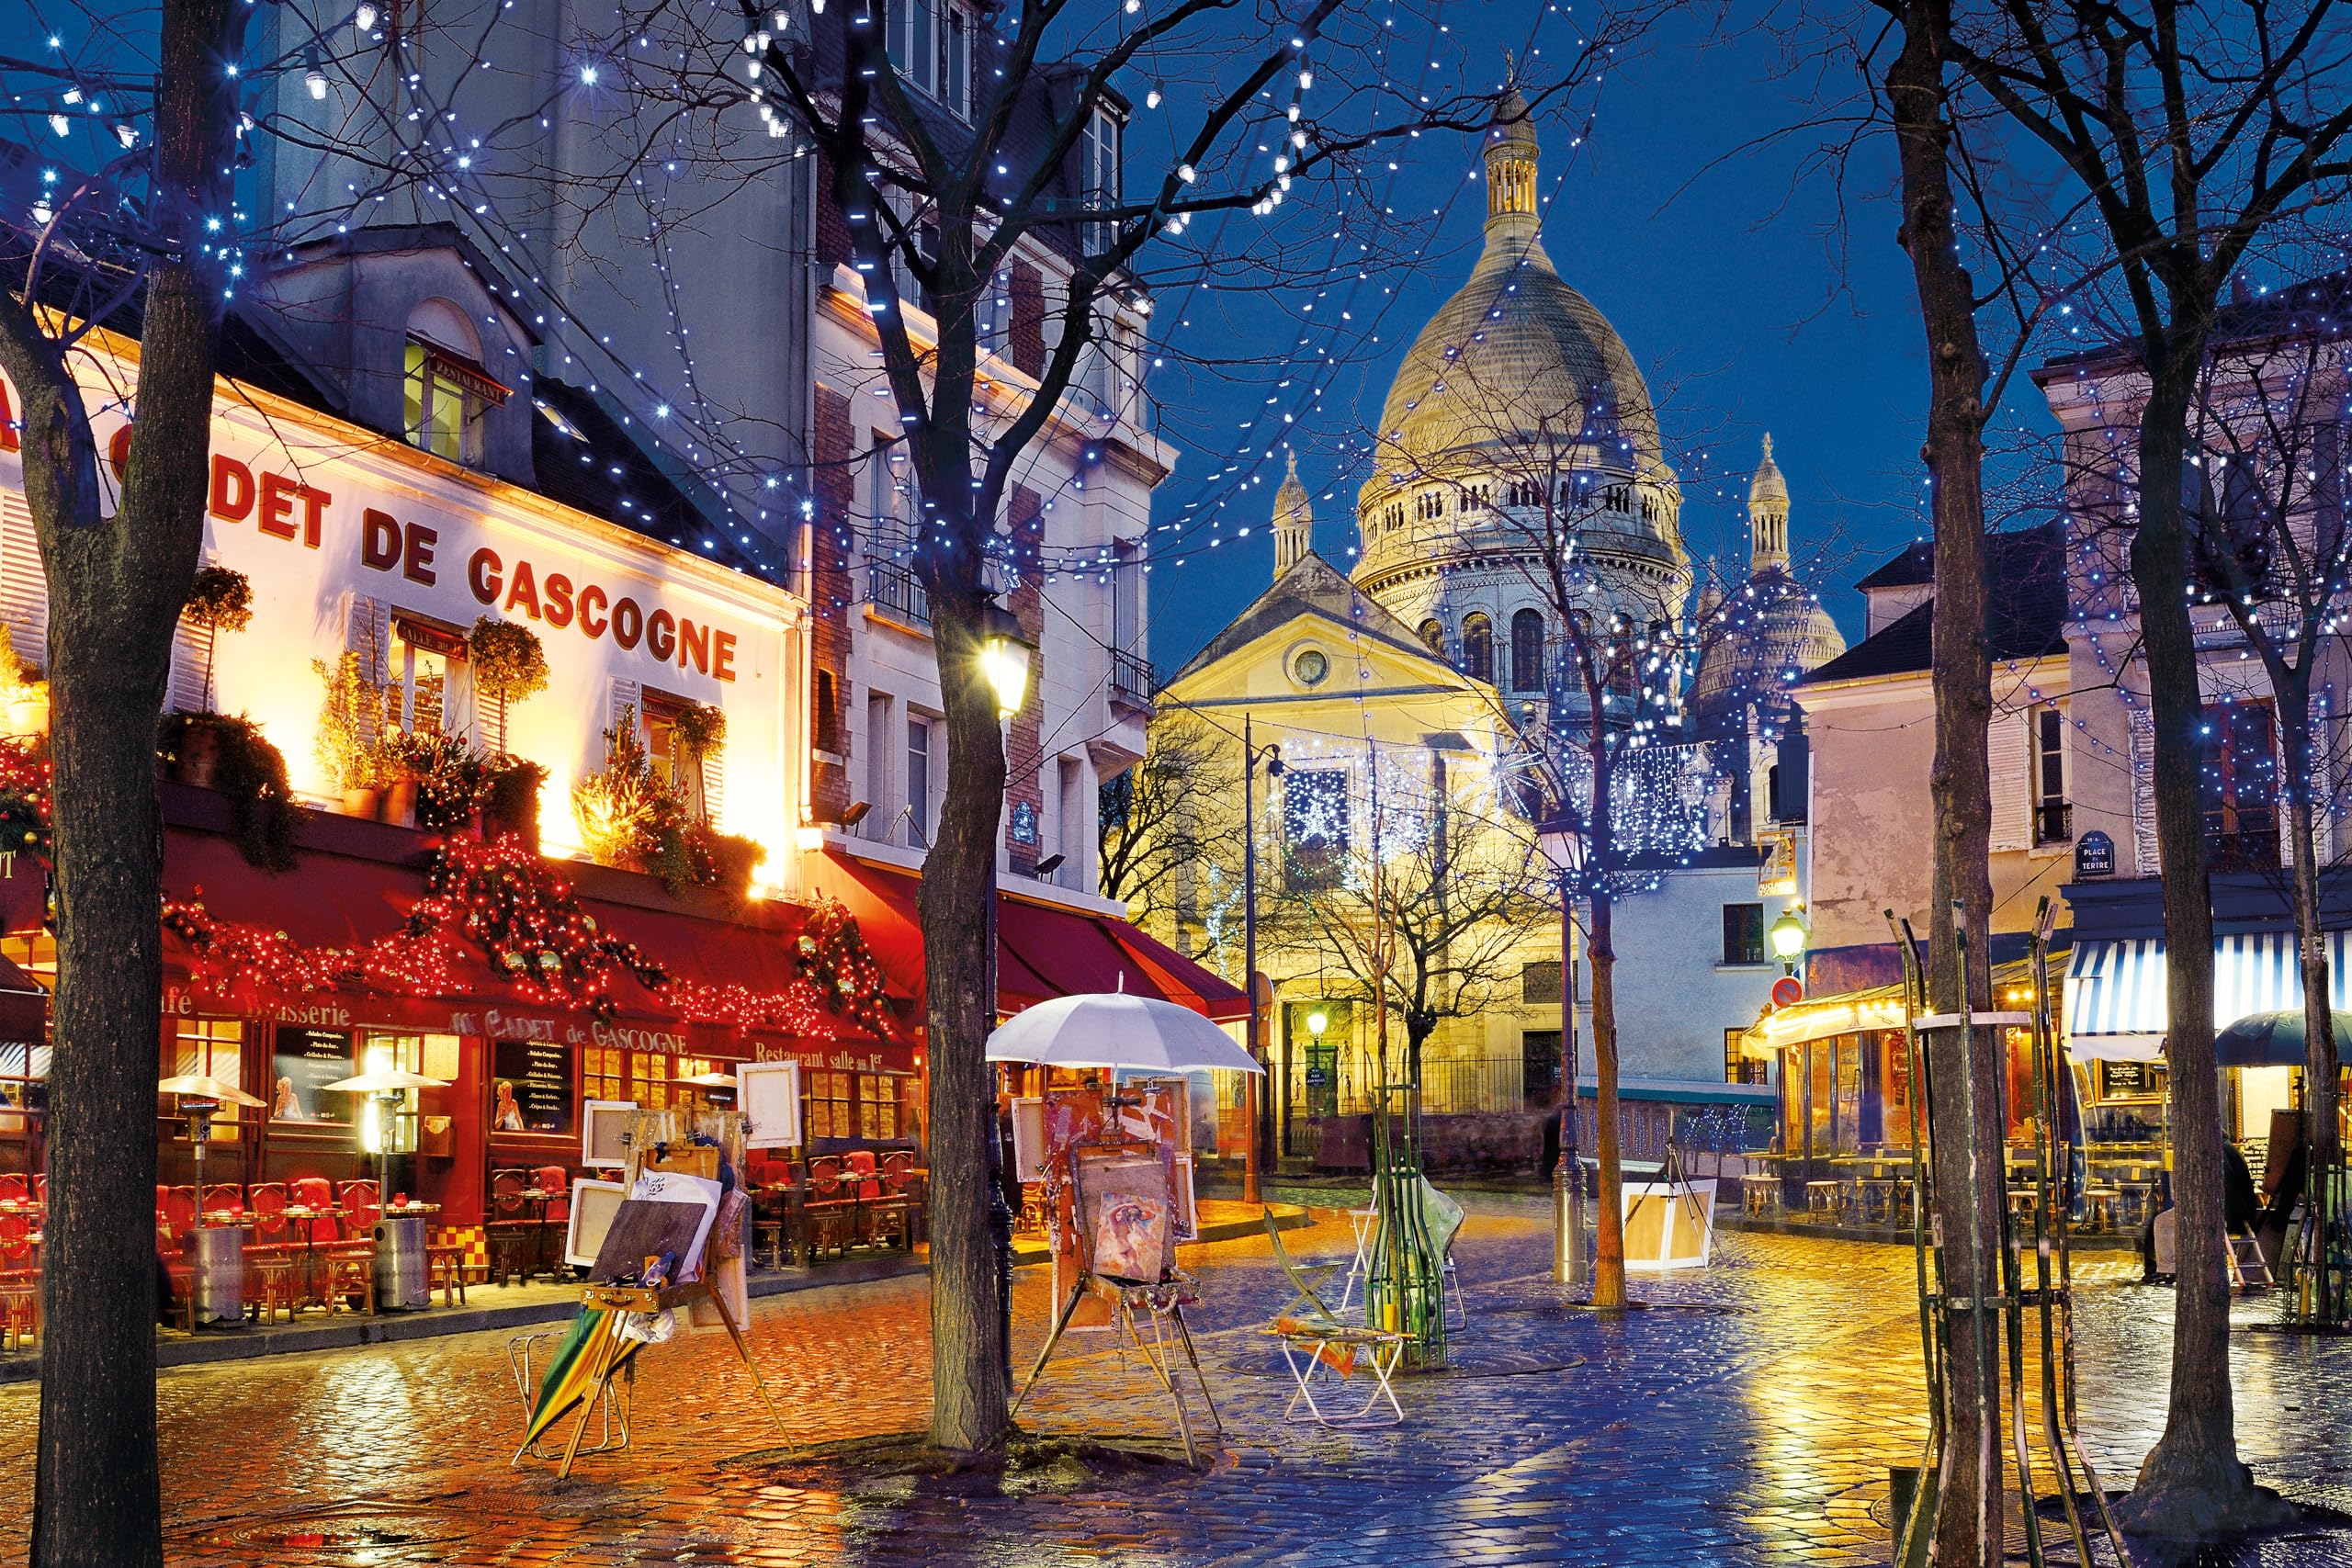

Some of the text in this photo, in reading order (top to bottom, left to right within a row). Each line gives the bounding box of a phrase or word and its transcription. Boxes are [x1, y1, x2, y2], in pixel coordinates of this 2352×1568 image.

[362, 507, 438, 587] DE
[468, 547, 737, 682] GASCOGNE
[2082, 861, 2109, 870] TERTRE
[2084, 848, 2106, 856] PLACE
[566, 1023, 587, 1044] de
[591, 1021, 689, 1055] GASCOGNE
[755, 1042, 825, 1067] Restaurant
[830, 1050, 854, 1070] salle
